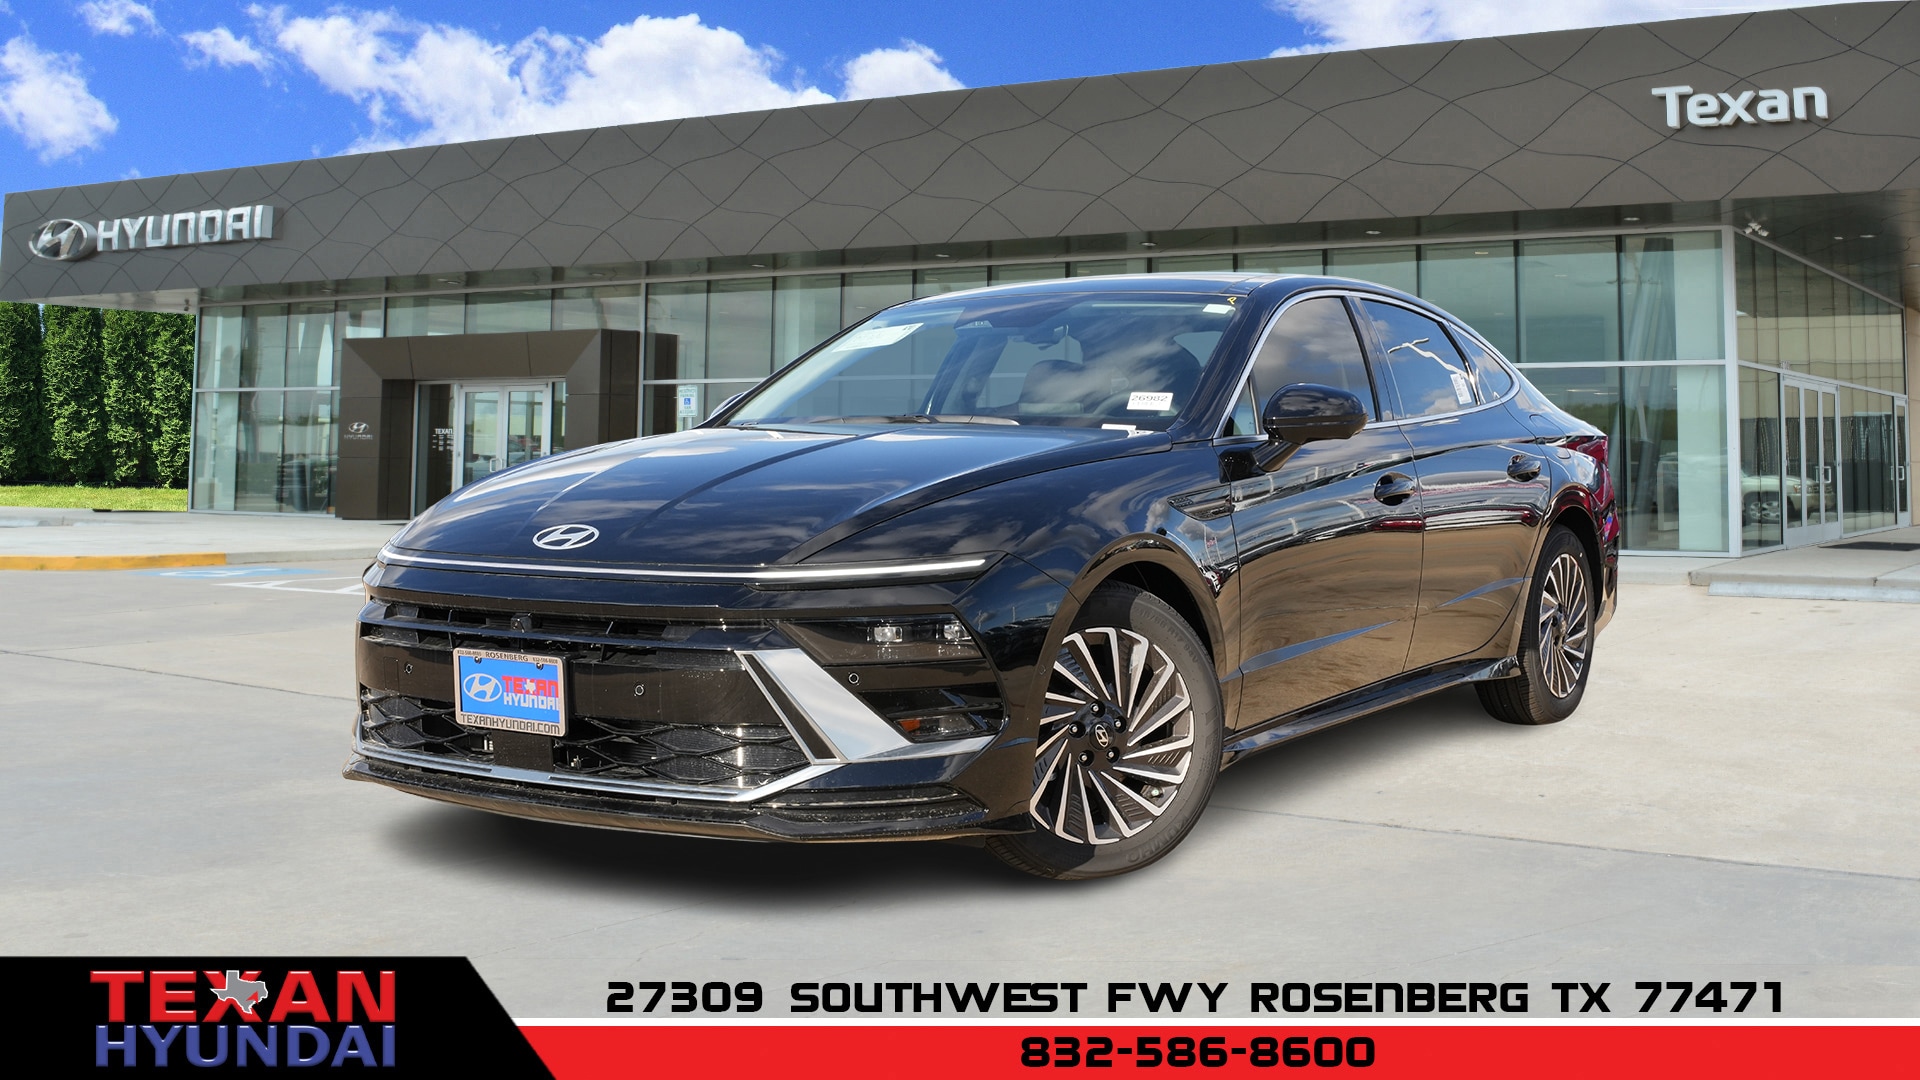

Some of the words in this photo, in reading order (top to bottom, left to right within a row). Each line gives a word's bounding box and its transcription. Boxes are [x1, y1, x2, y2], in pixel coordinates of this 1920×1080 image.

[1651, 85, 1829, 129] Texan
[97, 205, 273, 251] HYUNDAI
[485, 651, 529, 662] ROSENBERG
[501, 675, 559, 699] TEXAN
[503, 692, 560, 711] HYUNDAI
[460, 713, 560, 735] TEXANHYUNDAI.COM
